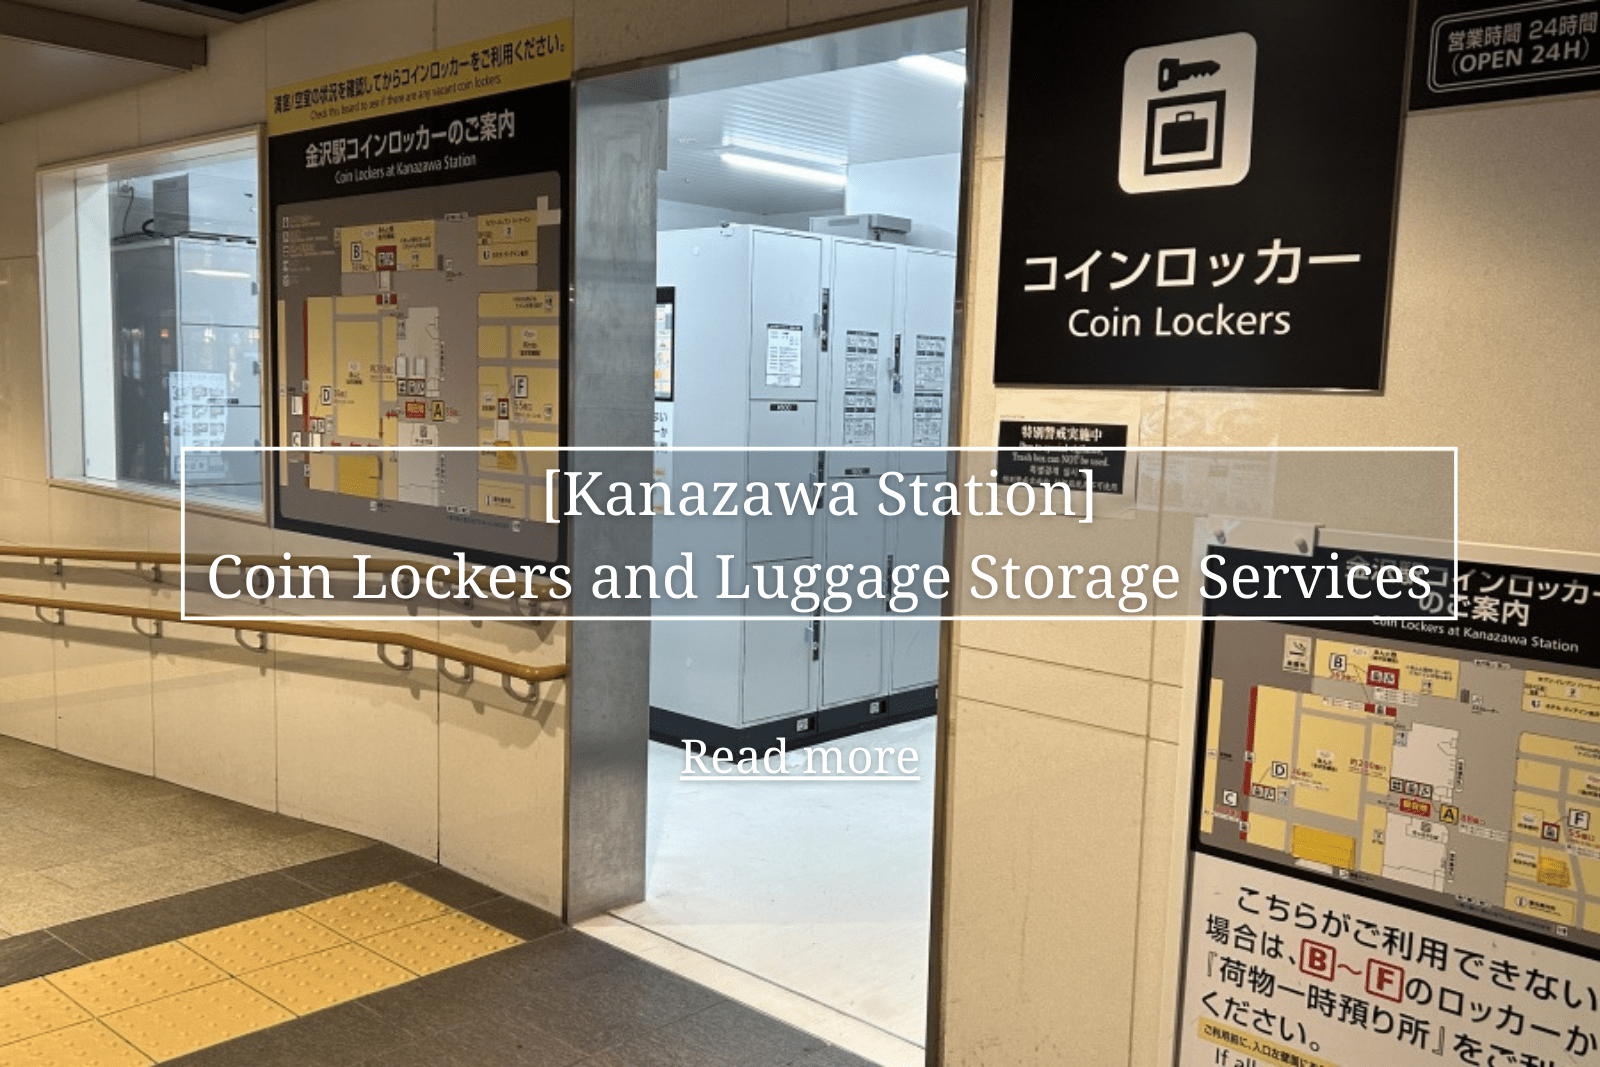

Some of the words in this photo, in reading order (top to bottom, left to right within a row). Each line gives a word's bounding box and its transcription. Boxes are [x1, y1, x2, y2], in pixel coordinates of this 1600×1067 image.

[1448, 22, 1522, 53] 営業時間
[1528, 11, 1598, 41] 24時間
[1452, 48, 1524, 77] (OPEN
[405, 93, 417, 103] are
[418, 91, 430, 102] any
[457, 80, 472, 92] coin
[474, 75, 501, 89] lockers
[305, 109, 516, 169] 金沢駅コインロッカーのご案内
[335, 168, 354, 185] Coin
[355, 162, 385, 182] Lockers
[386, 162, 396, 177] at
[396, 156, 442, 176] Kanazawa
[444, 152, 477, 170] Station
[1023, 238, 1362, 294] コインロッカー
[1068, 307, 1141, 338] Coin
[1155, 303, 1291, 337] Lockers
[1020, 425, 1104, 443] 特別警戒実施中
[1012, 451, 1032, 462] Trash
[1047, 456, 1060, 464] can
[1061, 454, 1079, 466] NOT
[1080, 455, 1089, 465] be
[1346, 555, 1600, 605] 金沢駅コインロッカ
[1419, 592, 1530, 627] のご案内
[1401, 620, 1445, 636] Lockers
[1447, 625, 1460, 637] at
[1463, 627, 1528, 647] Kanazawa
[1531, 635, 1580, 654] Station
[1274, 764, 1285, 777] D
[1442, 808, 1455, 821] A
[1237, 887, 1598, 1012] こちらがご利用できない
[1202, 991, 1321, 1053] ください。
[1216, 1047, 1230, 1066] If
